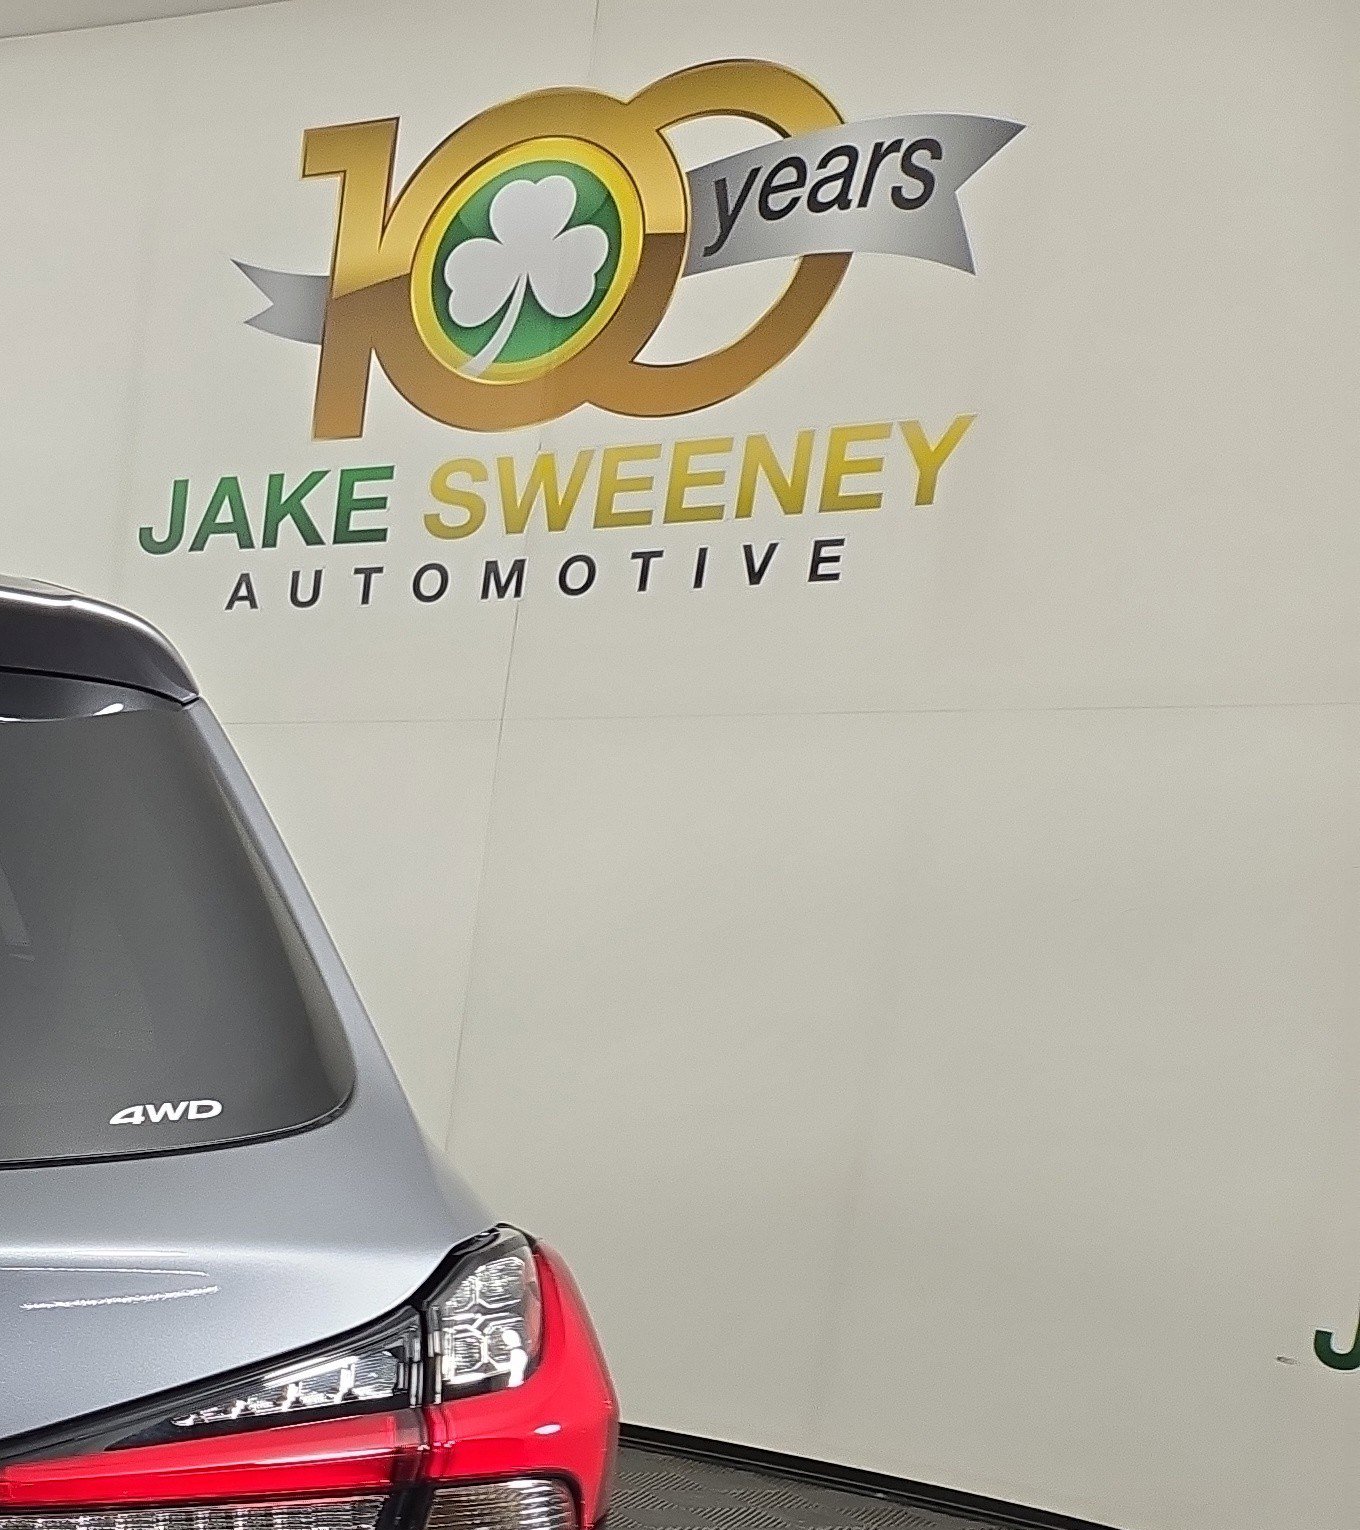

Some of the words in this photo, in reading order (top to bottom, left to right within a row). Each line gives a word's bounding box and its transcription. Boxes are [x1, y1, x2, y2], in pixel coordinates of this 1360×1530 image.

[302, 58, 852, 442] 100
[704, 131, 943, 257] years
[139, 465, 397, 556] JAKE
[423, 414, 977, 541] SWEENEY
[225, 537, 847, 612] AUTOMOTIVE
[109, 1099, 223, 1125] 4WD
